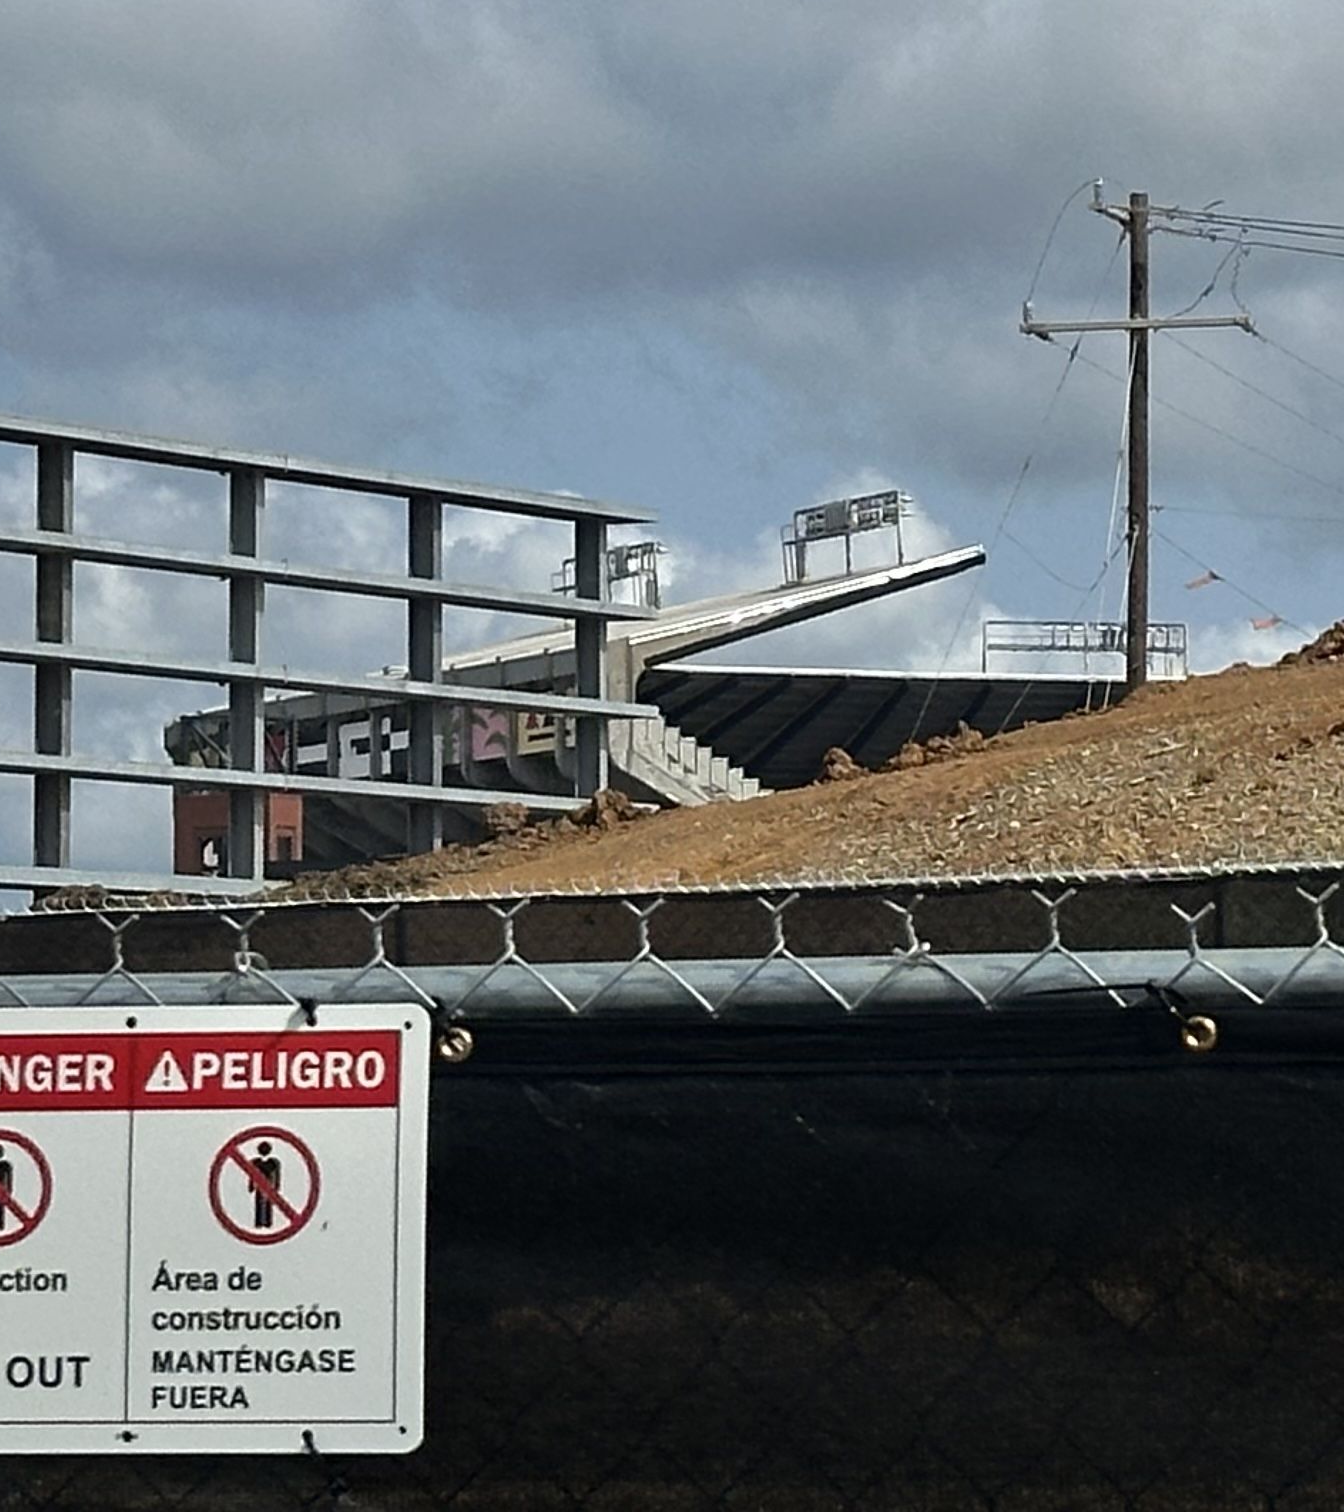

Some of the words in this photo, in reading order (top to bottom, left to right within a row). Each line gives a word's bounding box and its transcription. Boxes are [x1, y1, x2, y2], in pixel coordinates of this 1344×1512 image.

[192, 1050, 386, 1090] PELIGRO
[151, 1260, 219, 1291] Área
[227, 1265, 262, 1291] de
[151, 1303, 341, 1331] construcción
[6, 1355, 91, 1389] OUT
[151, 1344, 356, 1374] MANTÉNGASE
[151, 1385, 250, 1410] FUERA
